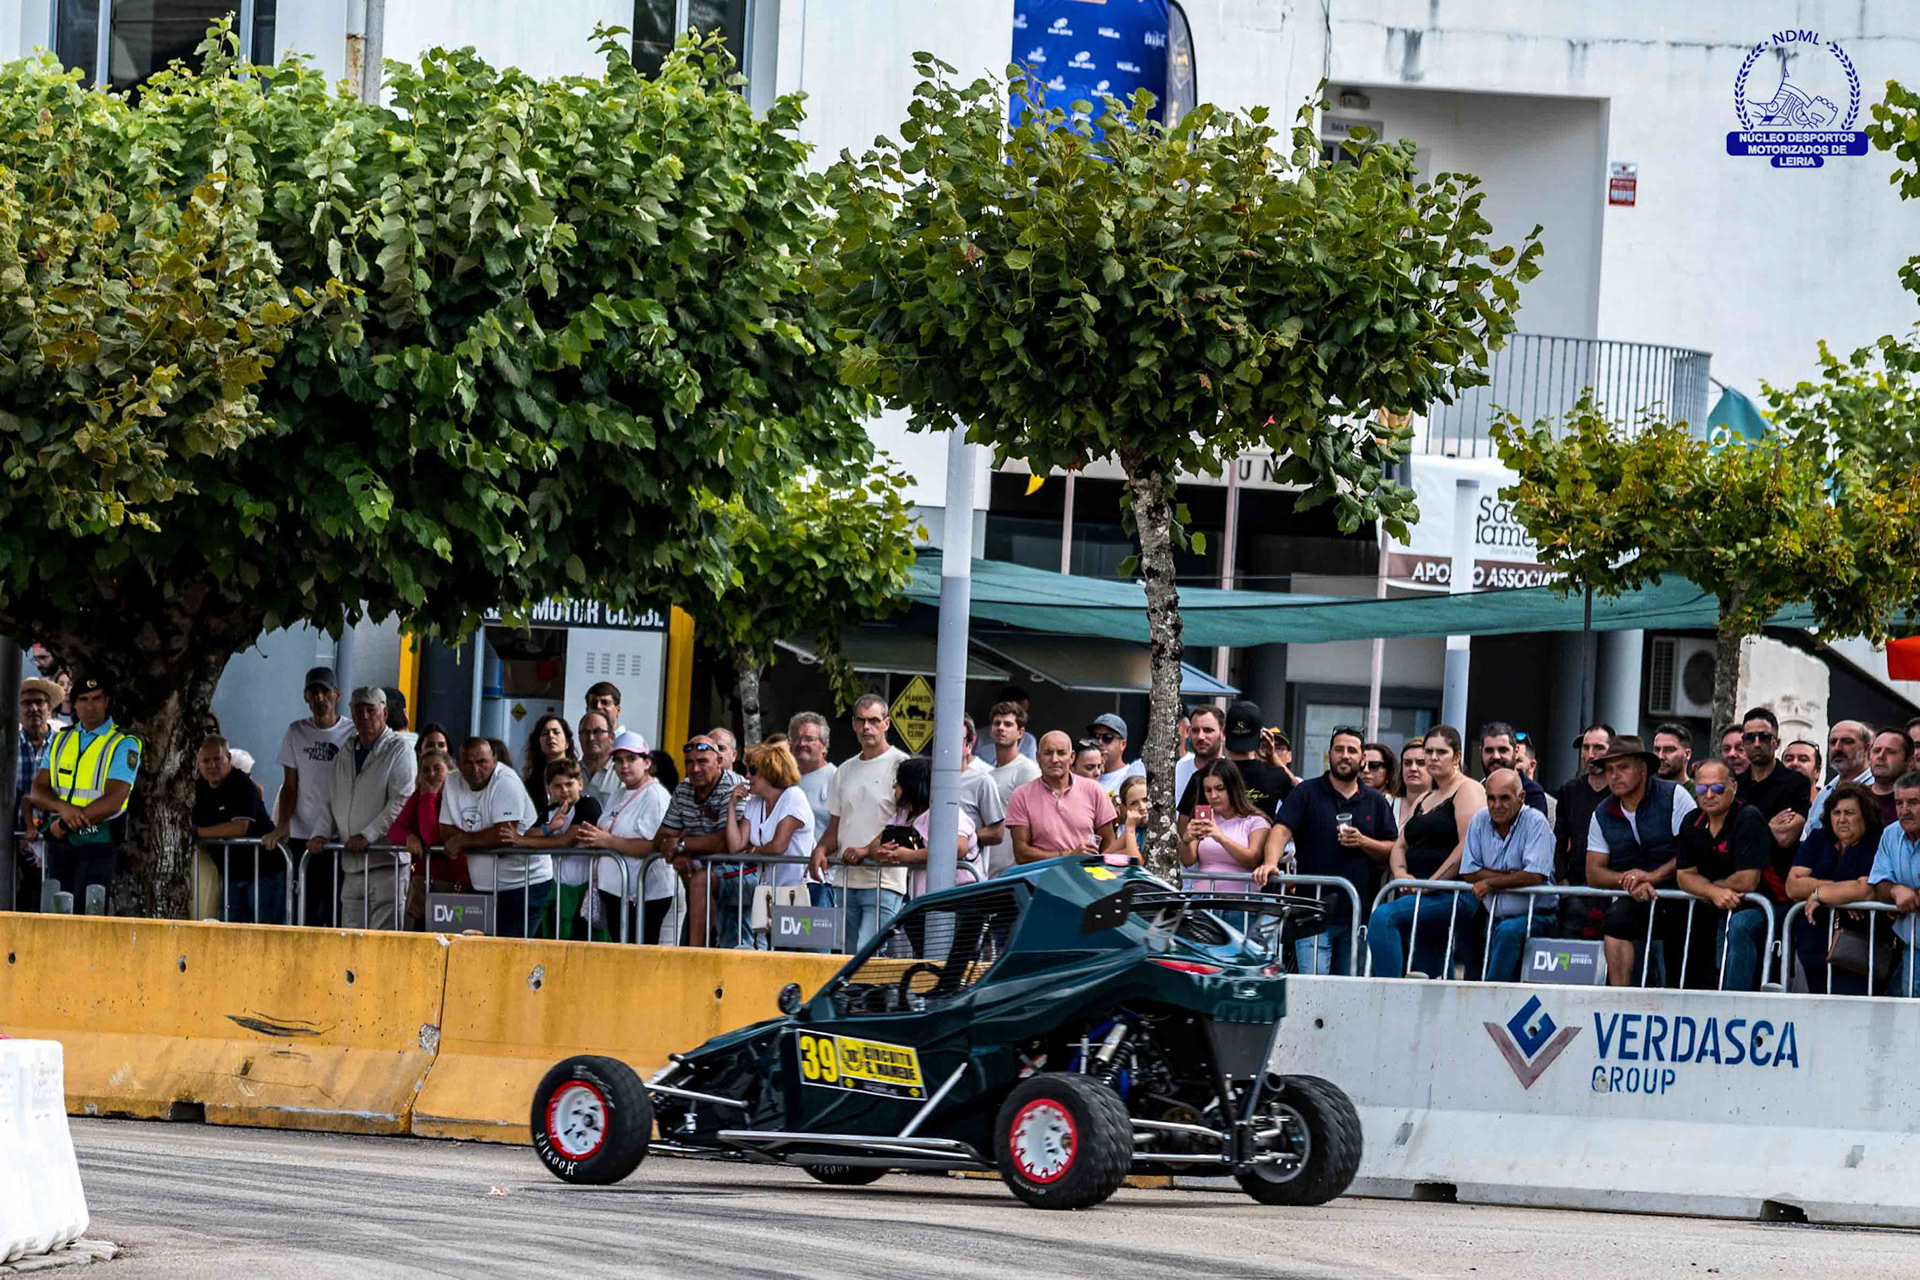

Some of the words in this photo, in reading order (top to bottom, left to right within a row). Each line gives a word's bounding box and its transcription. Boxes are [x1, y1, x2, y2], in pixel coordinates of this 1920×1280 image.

[800, 1035, 839, 1083] 39
[1594, 1012, 1799, 1068] VERDASCA
[1591, 1066, 1676, 1094] GROUP
